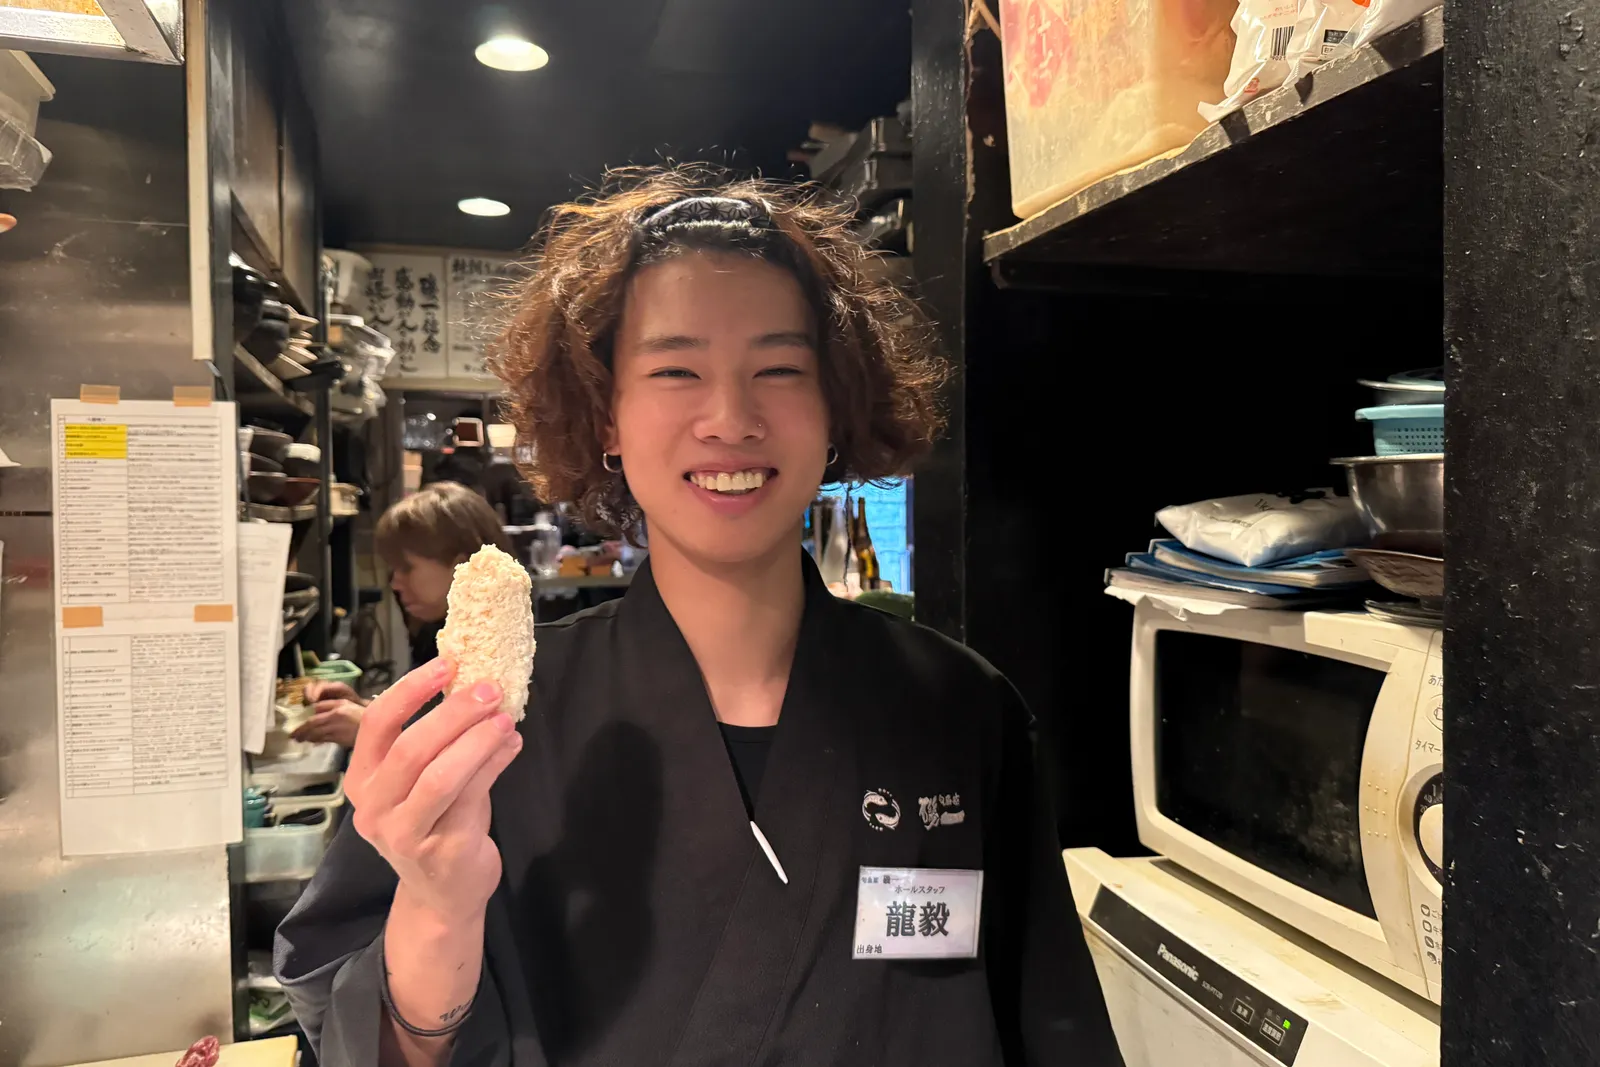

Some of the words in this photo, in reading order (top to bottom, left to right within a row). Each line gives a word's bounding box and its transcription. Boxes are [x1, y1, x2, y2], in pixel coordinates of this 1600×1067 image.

[894, 886, 945, 894] ホールスタッフ
[886, 901, 950, 937] 龍毅
[856, 944, 883, 954] 出身地
[1157, 943, 1198, 981] Panasonic
